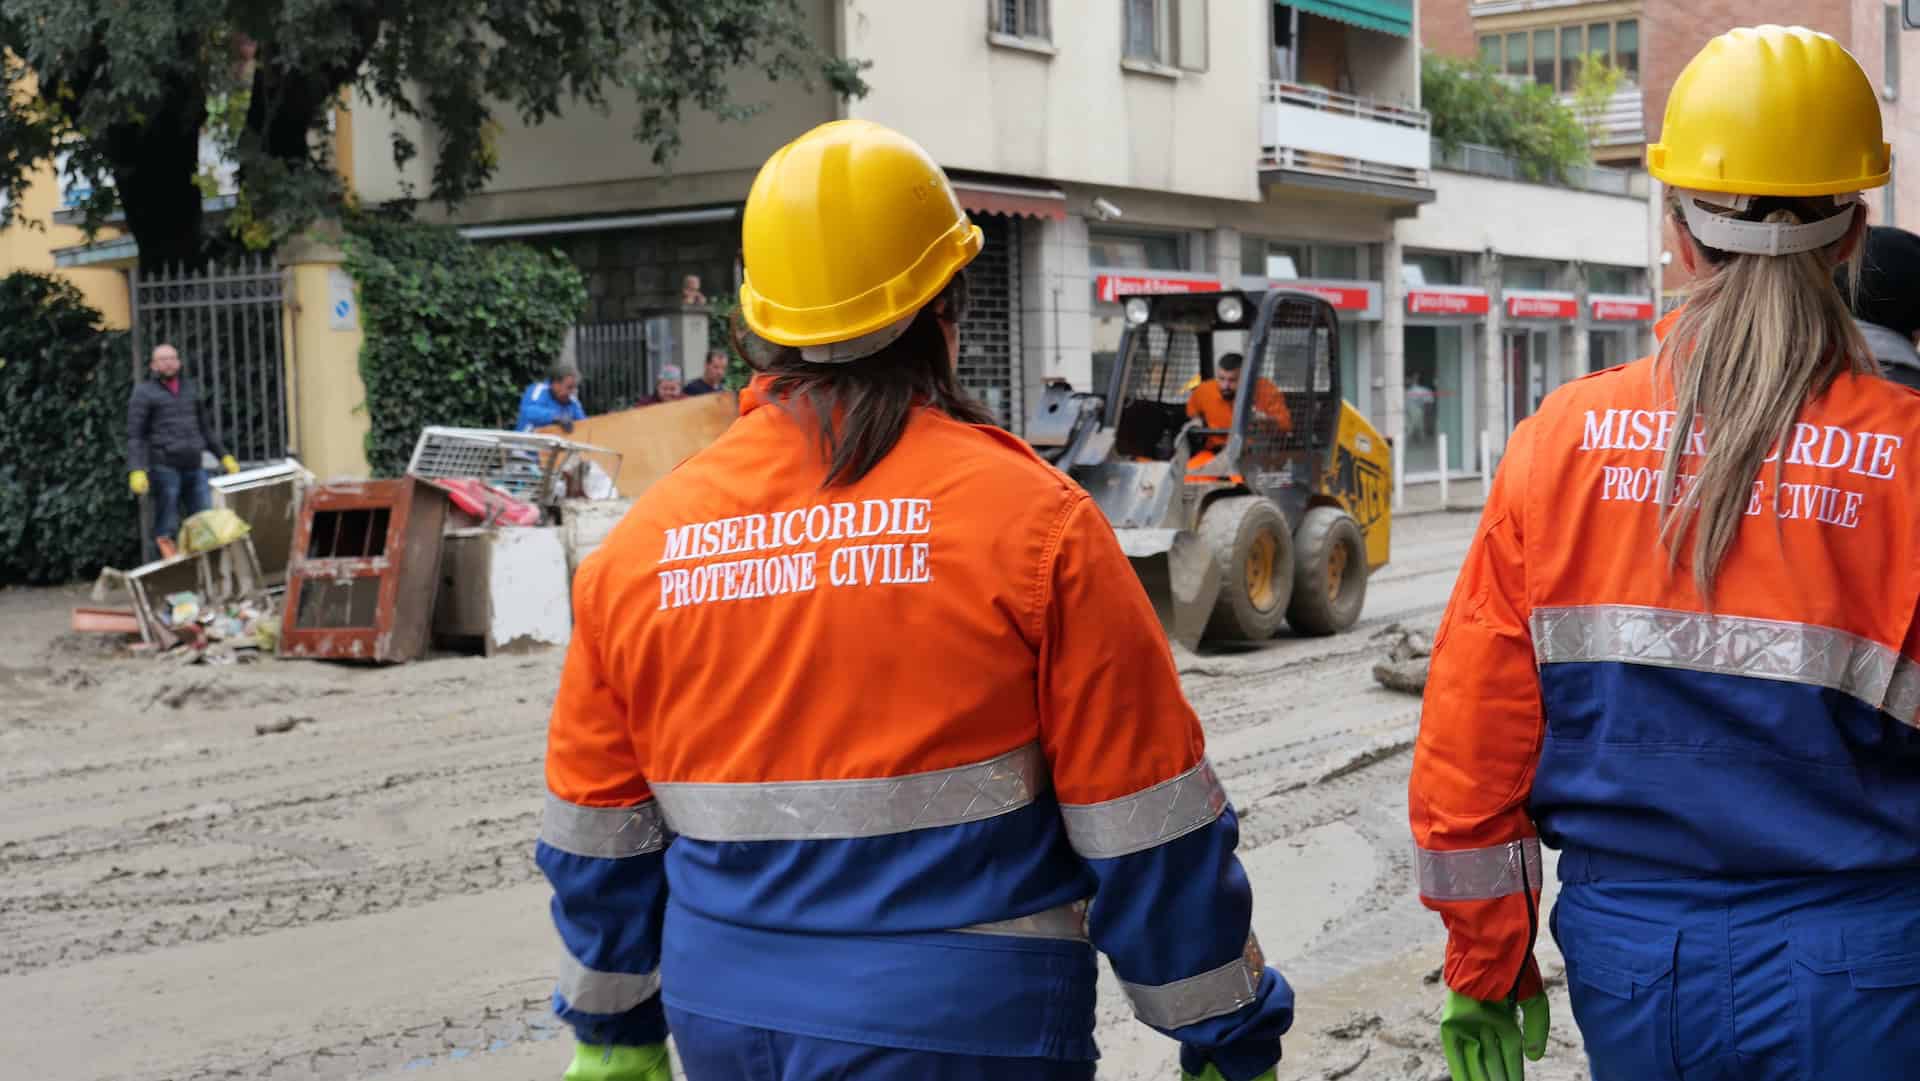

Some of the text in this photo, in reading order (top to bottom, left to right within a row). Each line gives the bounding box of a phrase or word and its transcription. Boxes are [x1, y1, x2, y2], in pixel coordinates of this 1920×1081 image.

[1579, 408, 1901, 480] MISERRDIE
[658, 498, 932, 564] MISERICORDIE
[1773, 482, 1863, 529] CIVILE
[657, 543, 931, 611] PROTEZIONE CIVILE
